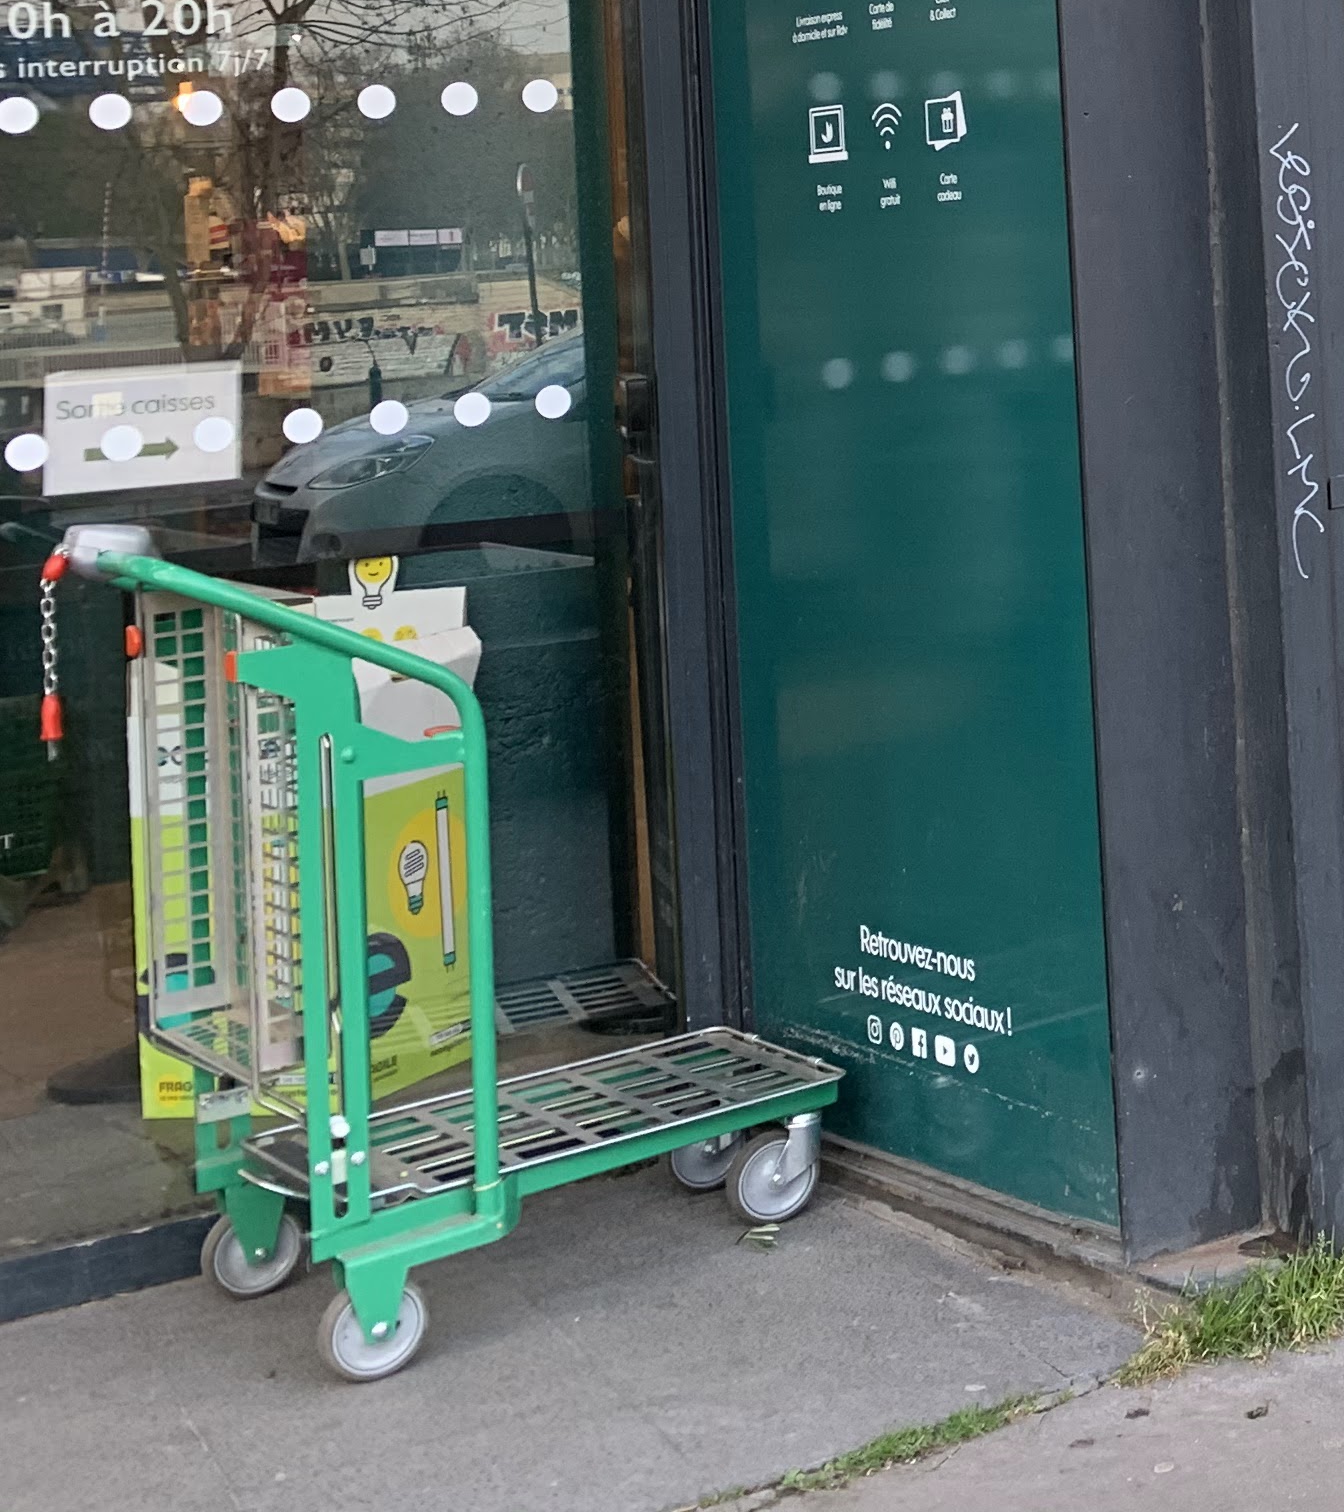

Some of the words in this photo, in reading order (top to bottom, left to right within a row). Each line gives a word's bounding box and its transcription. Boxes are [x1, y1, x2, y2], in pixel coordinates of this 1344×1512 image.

[94, 0, 120, 38] à
[18, 55, 203, 81] interruption
[217, 49, 269, 77] 7j/7
[131, 394, 216, 415] caisses
[859, 924, 976, 982] Retrouvez-nous
[834, 966, 856, 991] sur
[858, 966, 879, 998] les
[881, 975, 942, 1017] réseaux
[944, 996, 1005, 1037] sociaux
